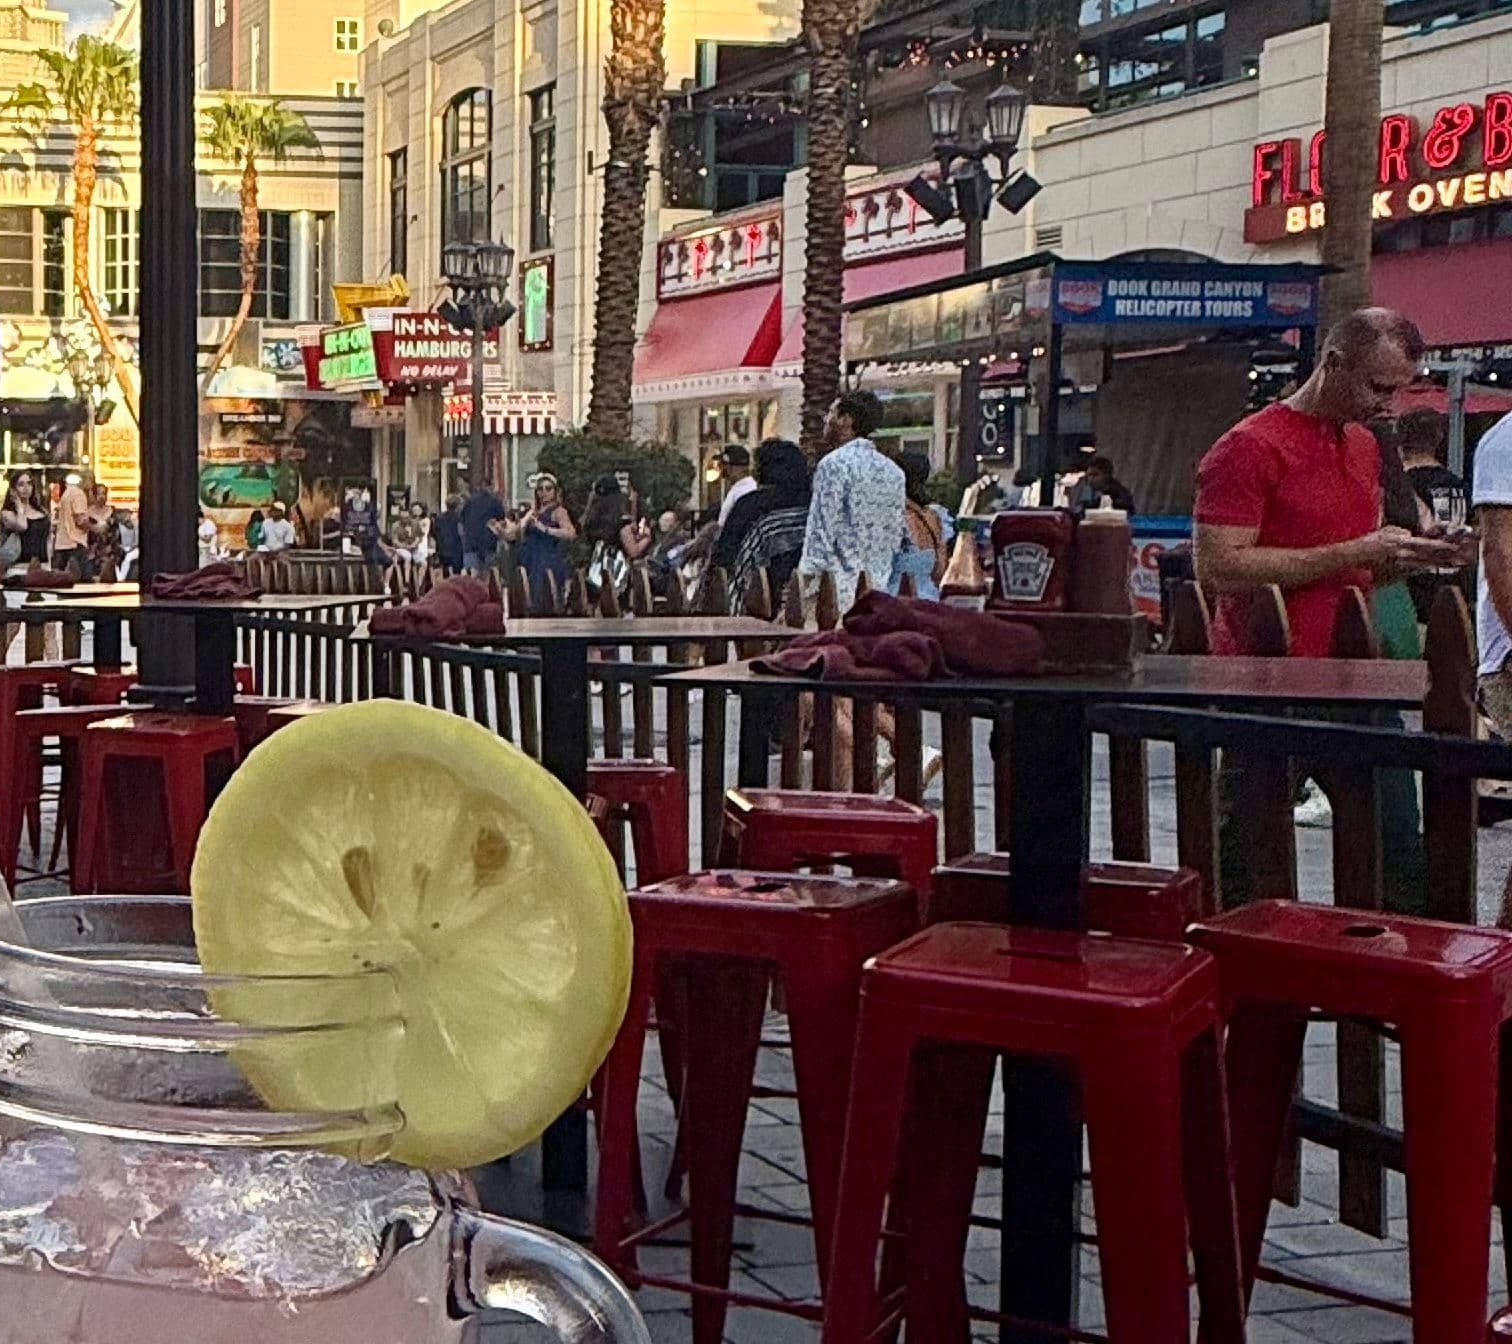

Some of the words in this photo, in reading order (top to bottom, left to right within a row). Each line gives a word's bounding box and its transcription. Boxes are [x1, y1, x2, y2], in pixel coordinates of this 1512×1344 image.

[1285, 190, 1393, 234] BRK
[1407, 168, 1512, 213] OVEN
[1150, 279, 1202, 297] GRAND
[1204, 280, 1264, 298] CANYON
[1115, 300, 1202, 317] HELICOPTER
[1204, 300, 1253, 317] TOURS
[394, 340, 498, 359] HAMBURGRS
[399, 365, 419, 377] NO
[422, 364, 459, 377] DELAY
